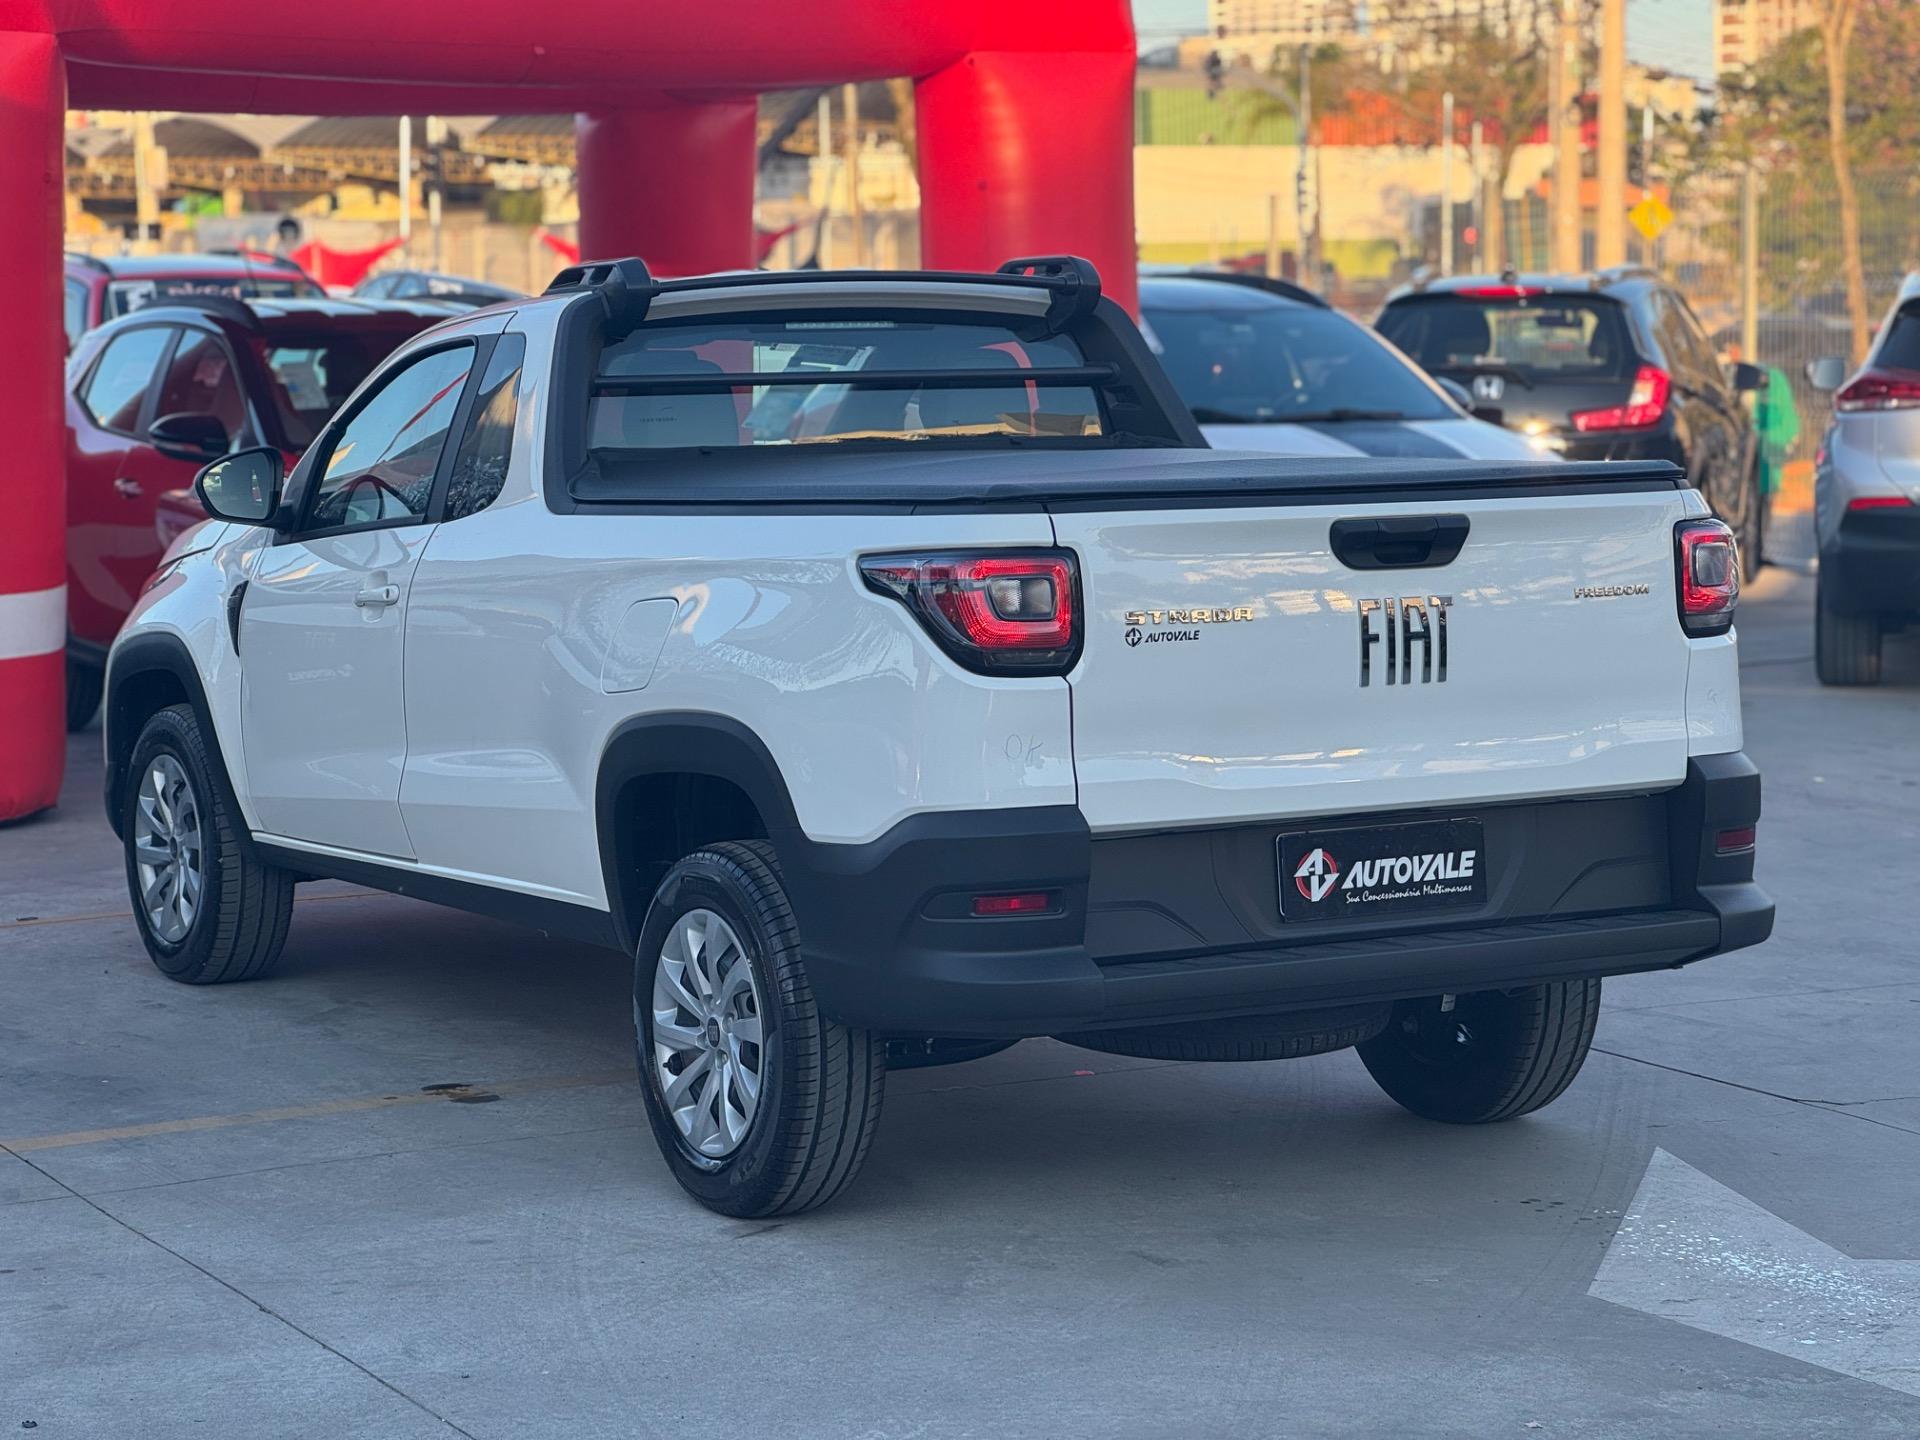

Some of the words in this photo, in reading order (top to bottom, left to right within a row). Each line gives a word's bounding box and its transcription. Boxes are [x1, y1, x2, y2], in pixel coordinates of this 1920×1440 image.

[1574, 583, 1650, 598] FREEDOM
[1125, 607, 1255, 626] STRADA
[1145, 630, 1201, 643] AUTOVALE
[1357, 595, 1454, 688] FIAT
[1341, 850, 1476, 890] AUTOVALE
[1345, 892, 1361, 904] Sua
[1362, 887, 1421, 902] Concessionária
[1423, 883, 1473, 896] Multimarcas
